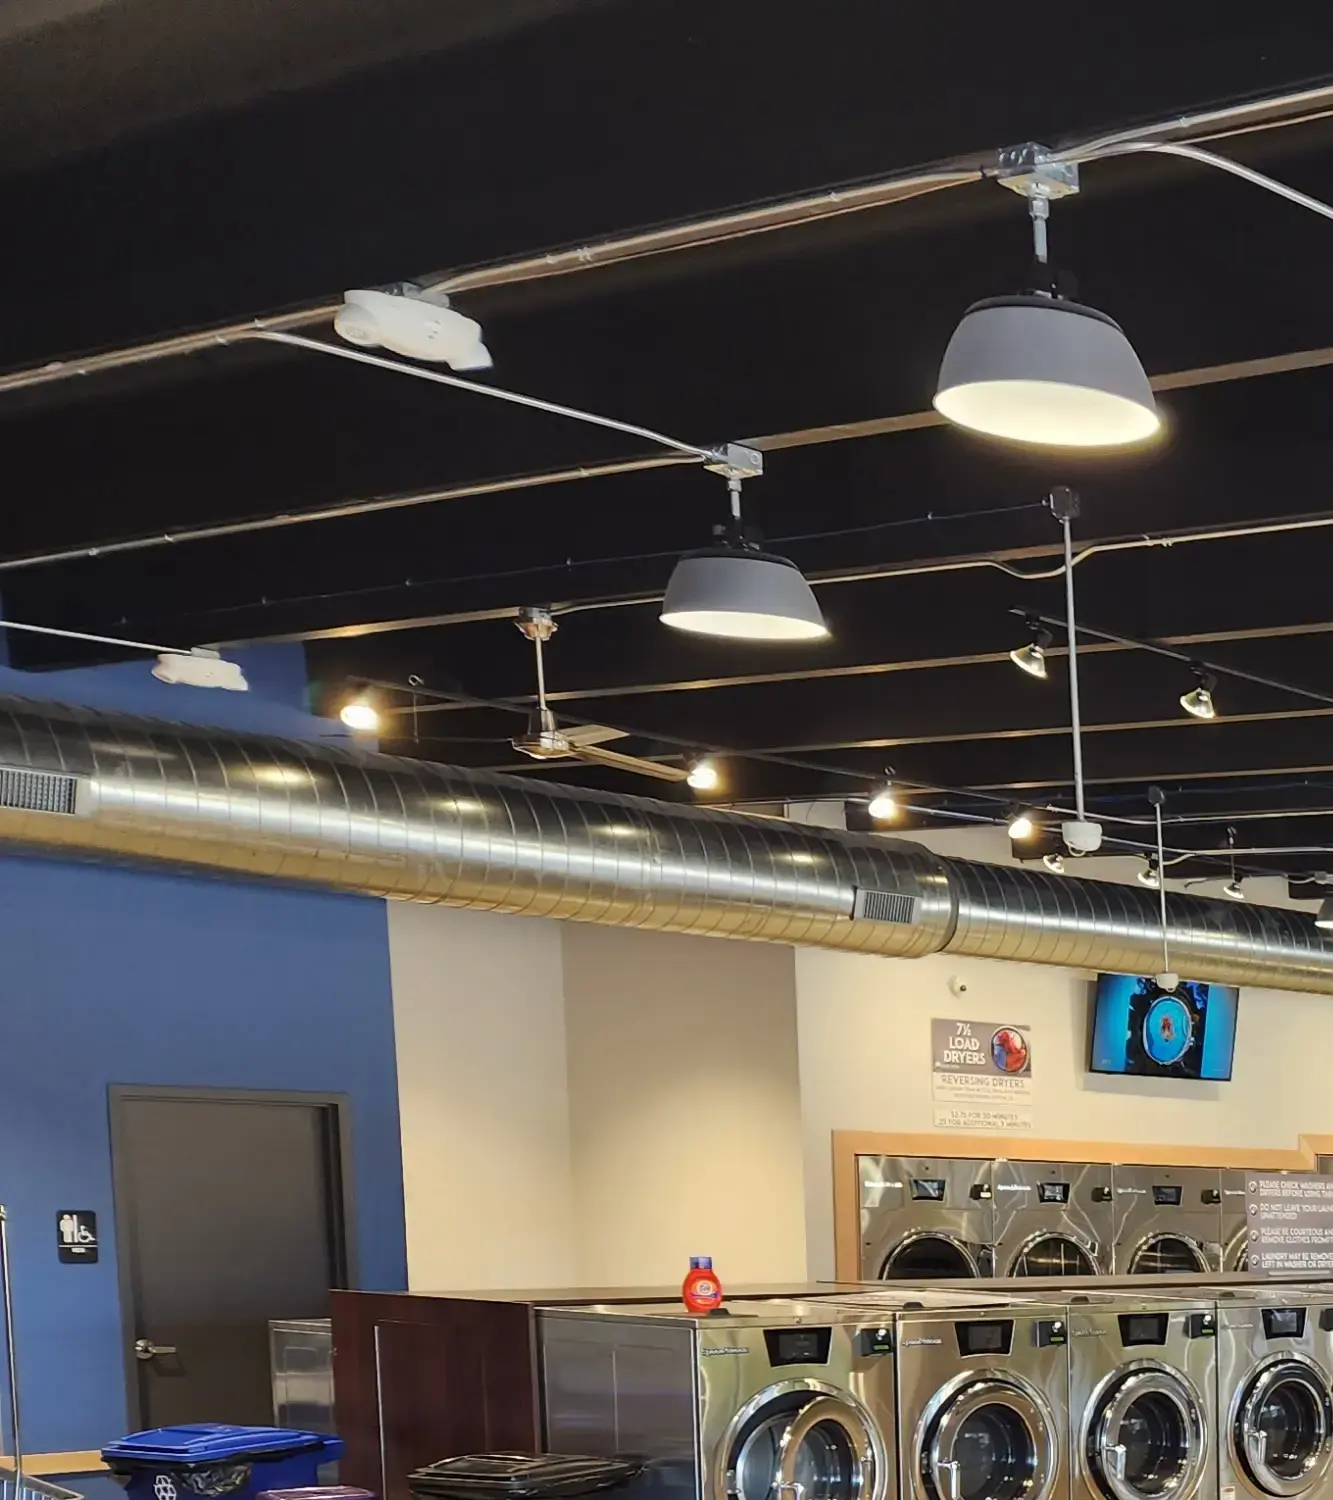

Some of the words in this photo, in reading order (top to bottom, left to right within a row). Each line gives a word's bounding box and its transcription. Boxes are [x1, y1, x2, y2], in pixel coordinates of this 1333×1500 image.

[949, 1036, 980, 1050] LOAD
[943, 1050, 986, 1065] DRYERS
[942, 1075, 990, 1087] REVERSING
[992, 1078, 1025, 1088] DRYERS
[1260, 1180, 1279, 1189] PLEASE
[1280, 1181, 1300, 1189] CHECK
[1300, 1182, 1325, 1190] WASHERS
[1282, 1189, 1303, 1197] BEFORE
[1260, 1203, 1269, 1211] DO
[1271, 1203, 1282, 1211] NOT
[1283, 1204, 1300, 1212] LEAVE
[1261, 1227, 1281, 1236] PLEASE
[1290, 1228, 1323, 1236] COURTEOUS
[1261, 1235, 1285, 1243] REMOVE
[1286, 1235, 1310, 1243] CLOTHES
[1262, 1252, 1288, 1260] LAUNDRY
[1262, 1260, 1275, 1268] LEFT
[1276, 1260, 1283, 1268] IN
[1283, 1260, 1307, 1268] WASHER
[1307, 1260, 1316, 1268] OR
